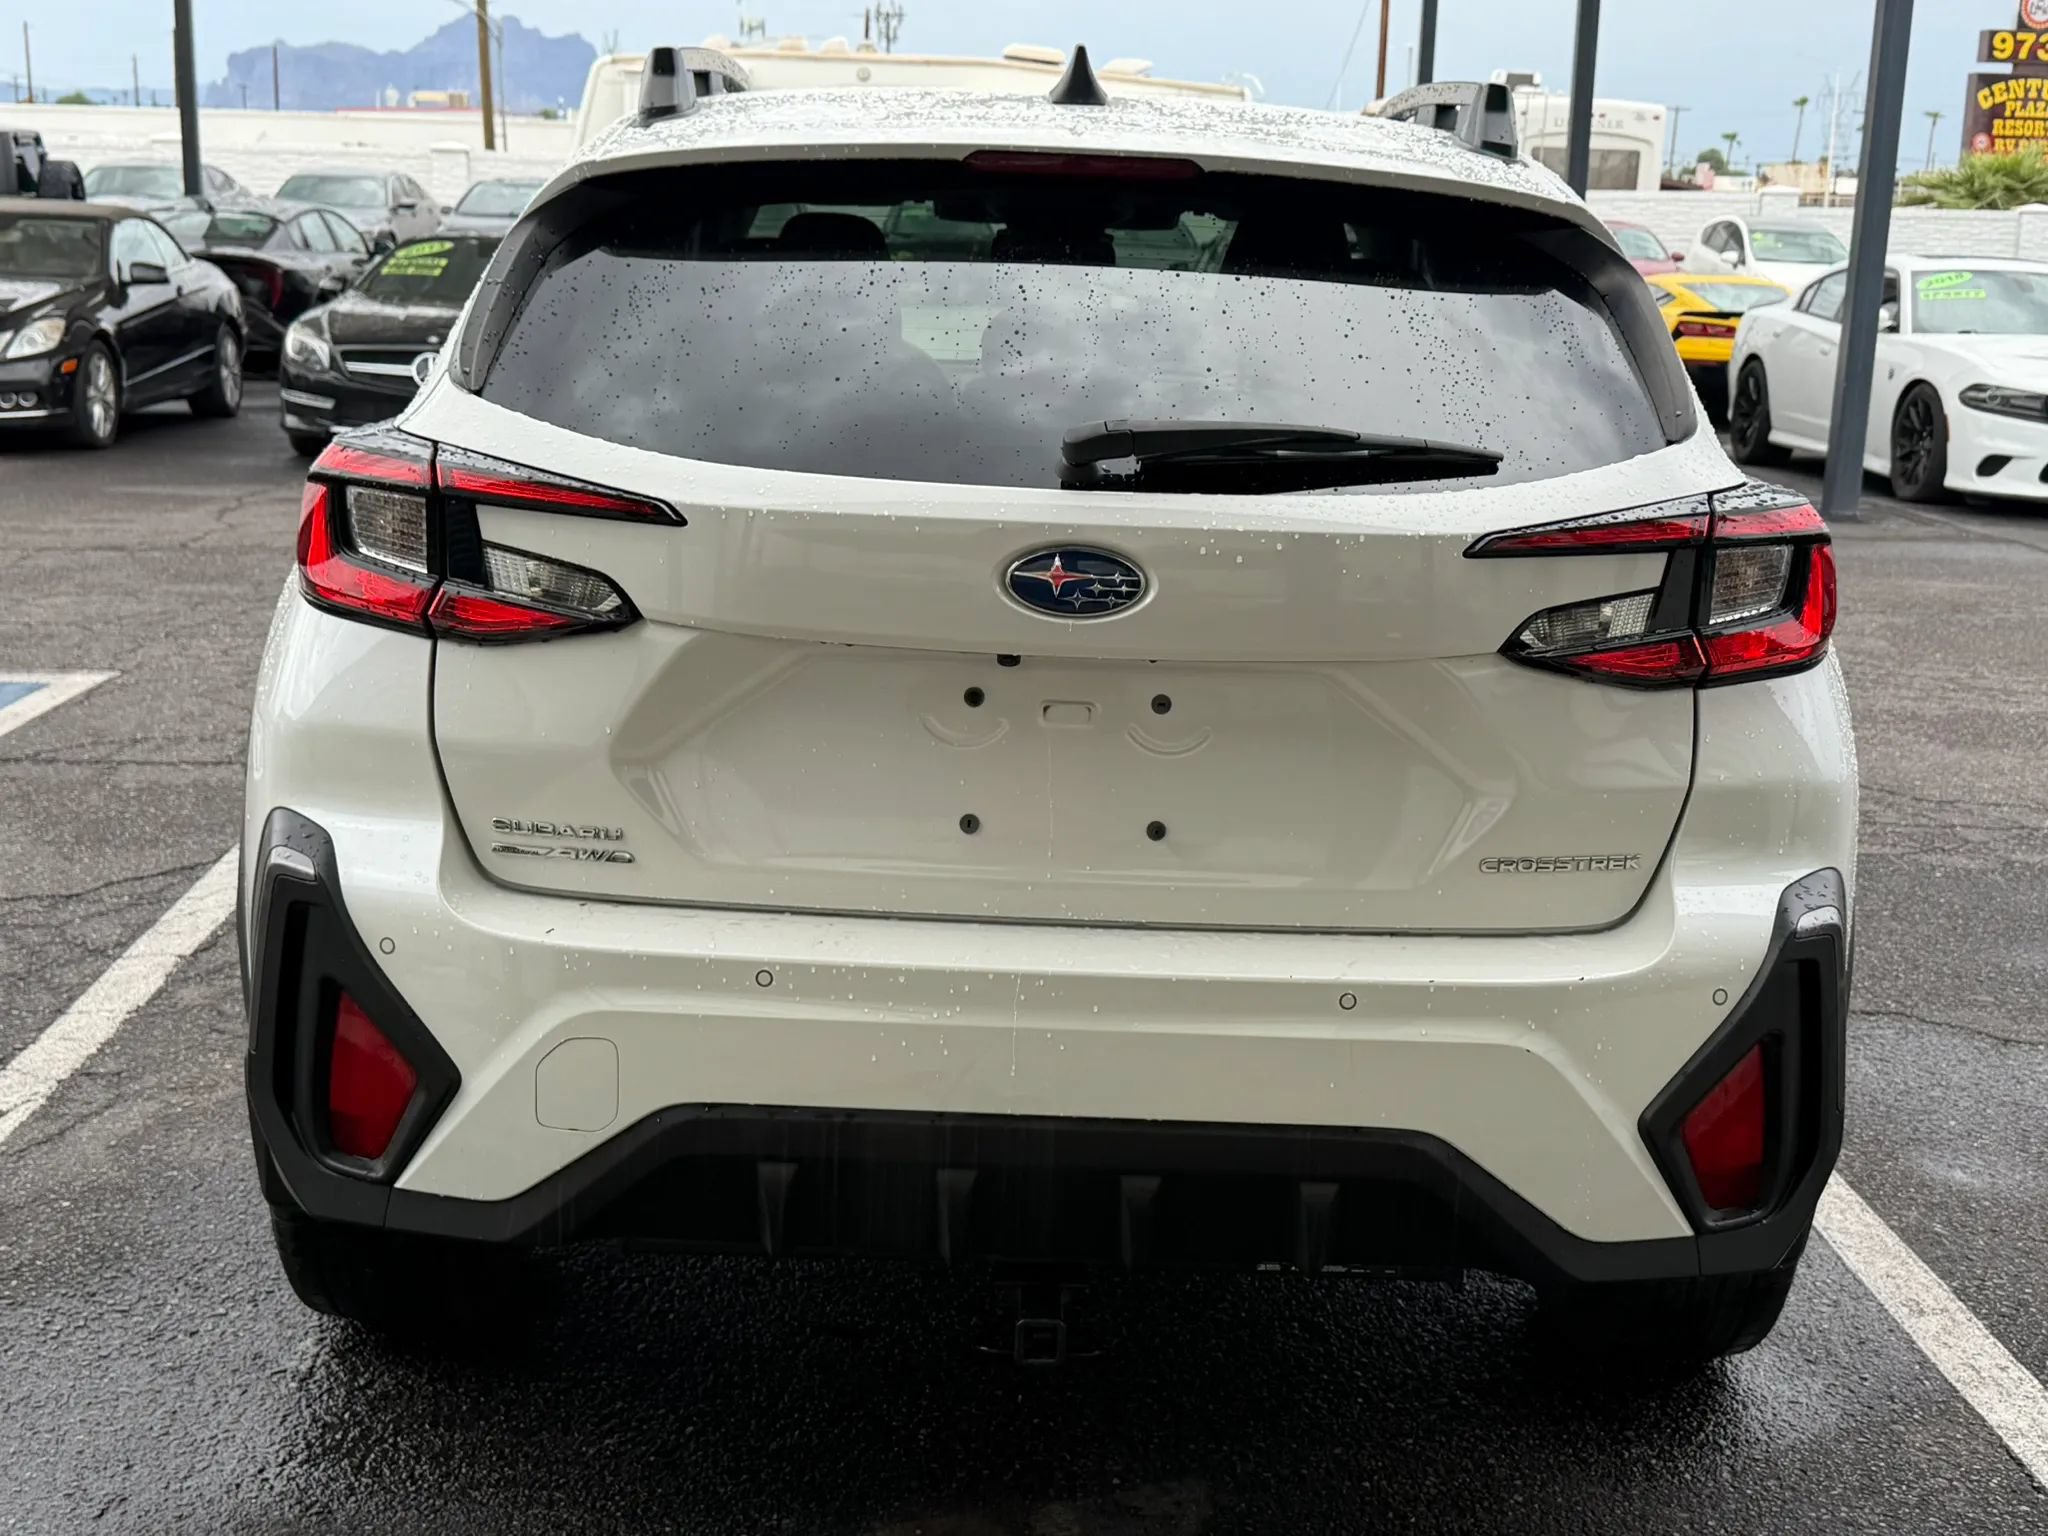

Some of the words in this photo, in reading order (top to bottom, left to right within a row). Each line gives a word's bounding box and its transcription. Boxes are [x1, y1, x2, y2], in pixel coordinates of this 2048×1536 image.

[2004, 101, 2048, 118] PLAZ
[1992, 119, 2048, 136] RESOR
[491, 817, 624, 840] SUBARU
[544, 847, 635, 863] AWD
[1480, 854, 1641, 873] CROSSTREK
